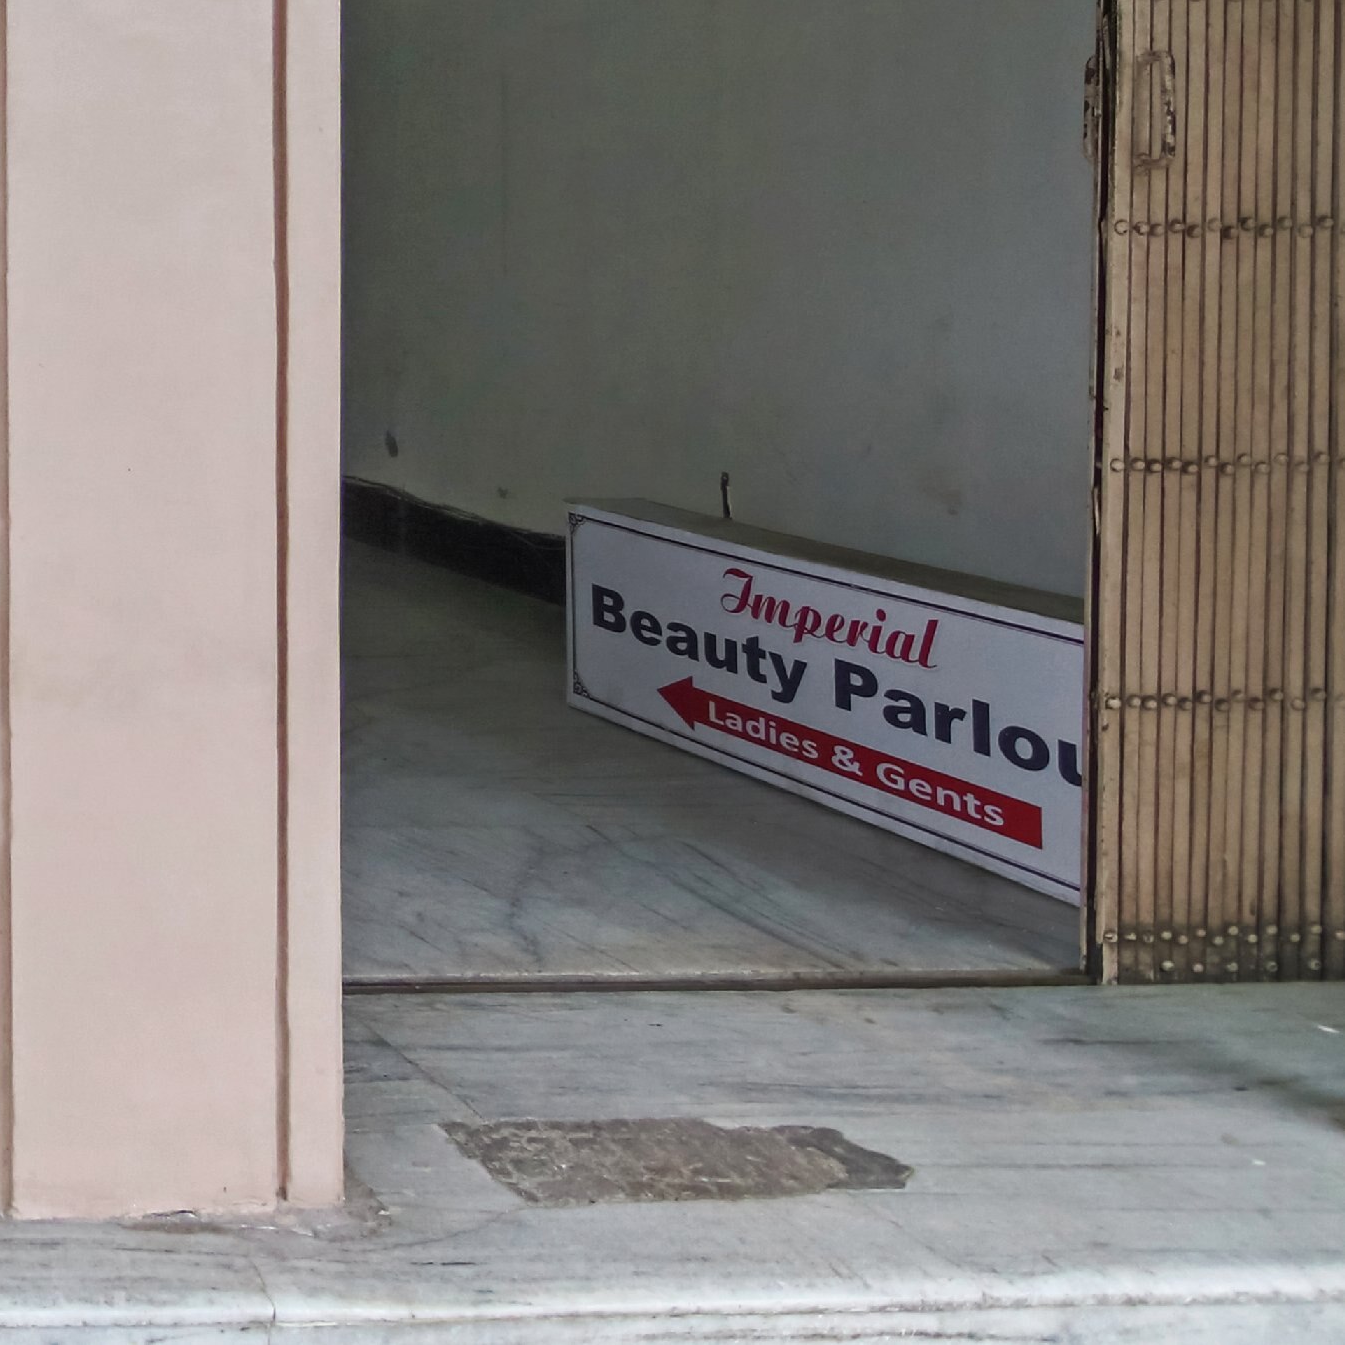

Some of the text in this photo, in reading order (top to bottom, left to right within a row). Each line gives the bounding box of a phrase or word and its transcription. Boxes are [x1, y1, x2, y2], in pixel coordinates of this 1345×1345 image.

[592, 583, 808, 703] Beauty
[720, 568, 939, 669] Imperial
[708, 700, 1006, 827] Ladies & Gents
